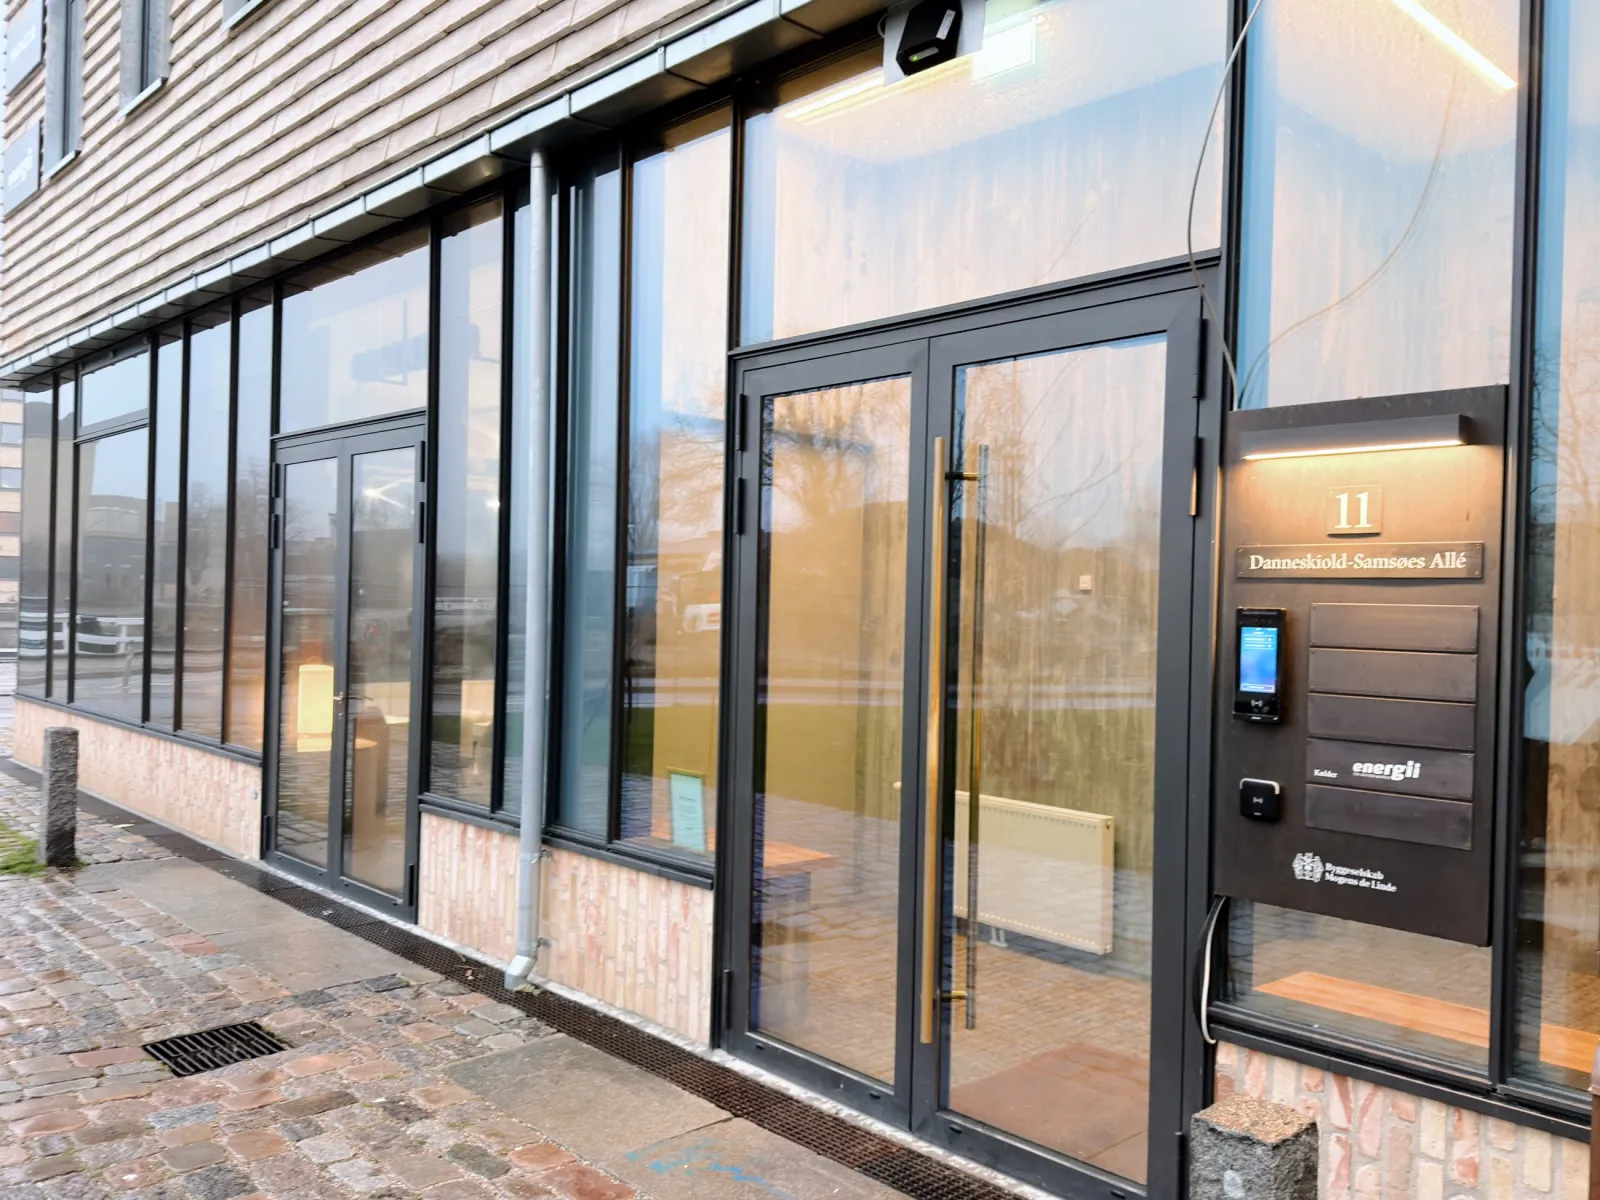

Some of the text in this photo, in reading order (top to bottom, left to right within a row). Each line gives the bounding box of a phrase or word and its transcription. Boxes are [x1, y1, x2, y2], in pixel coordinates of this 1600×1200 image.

[1334, 491, 1372, 529] 11
[1249, 551, 1467, 570] Danneskiold-Samsøes Allé
[1352, 760, 1421, 781] energii
